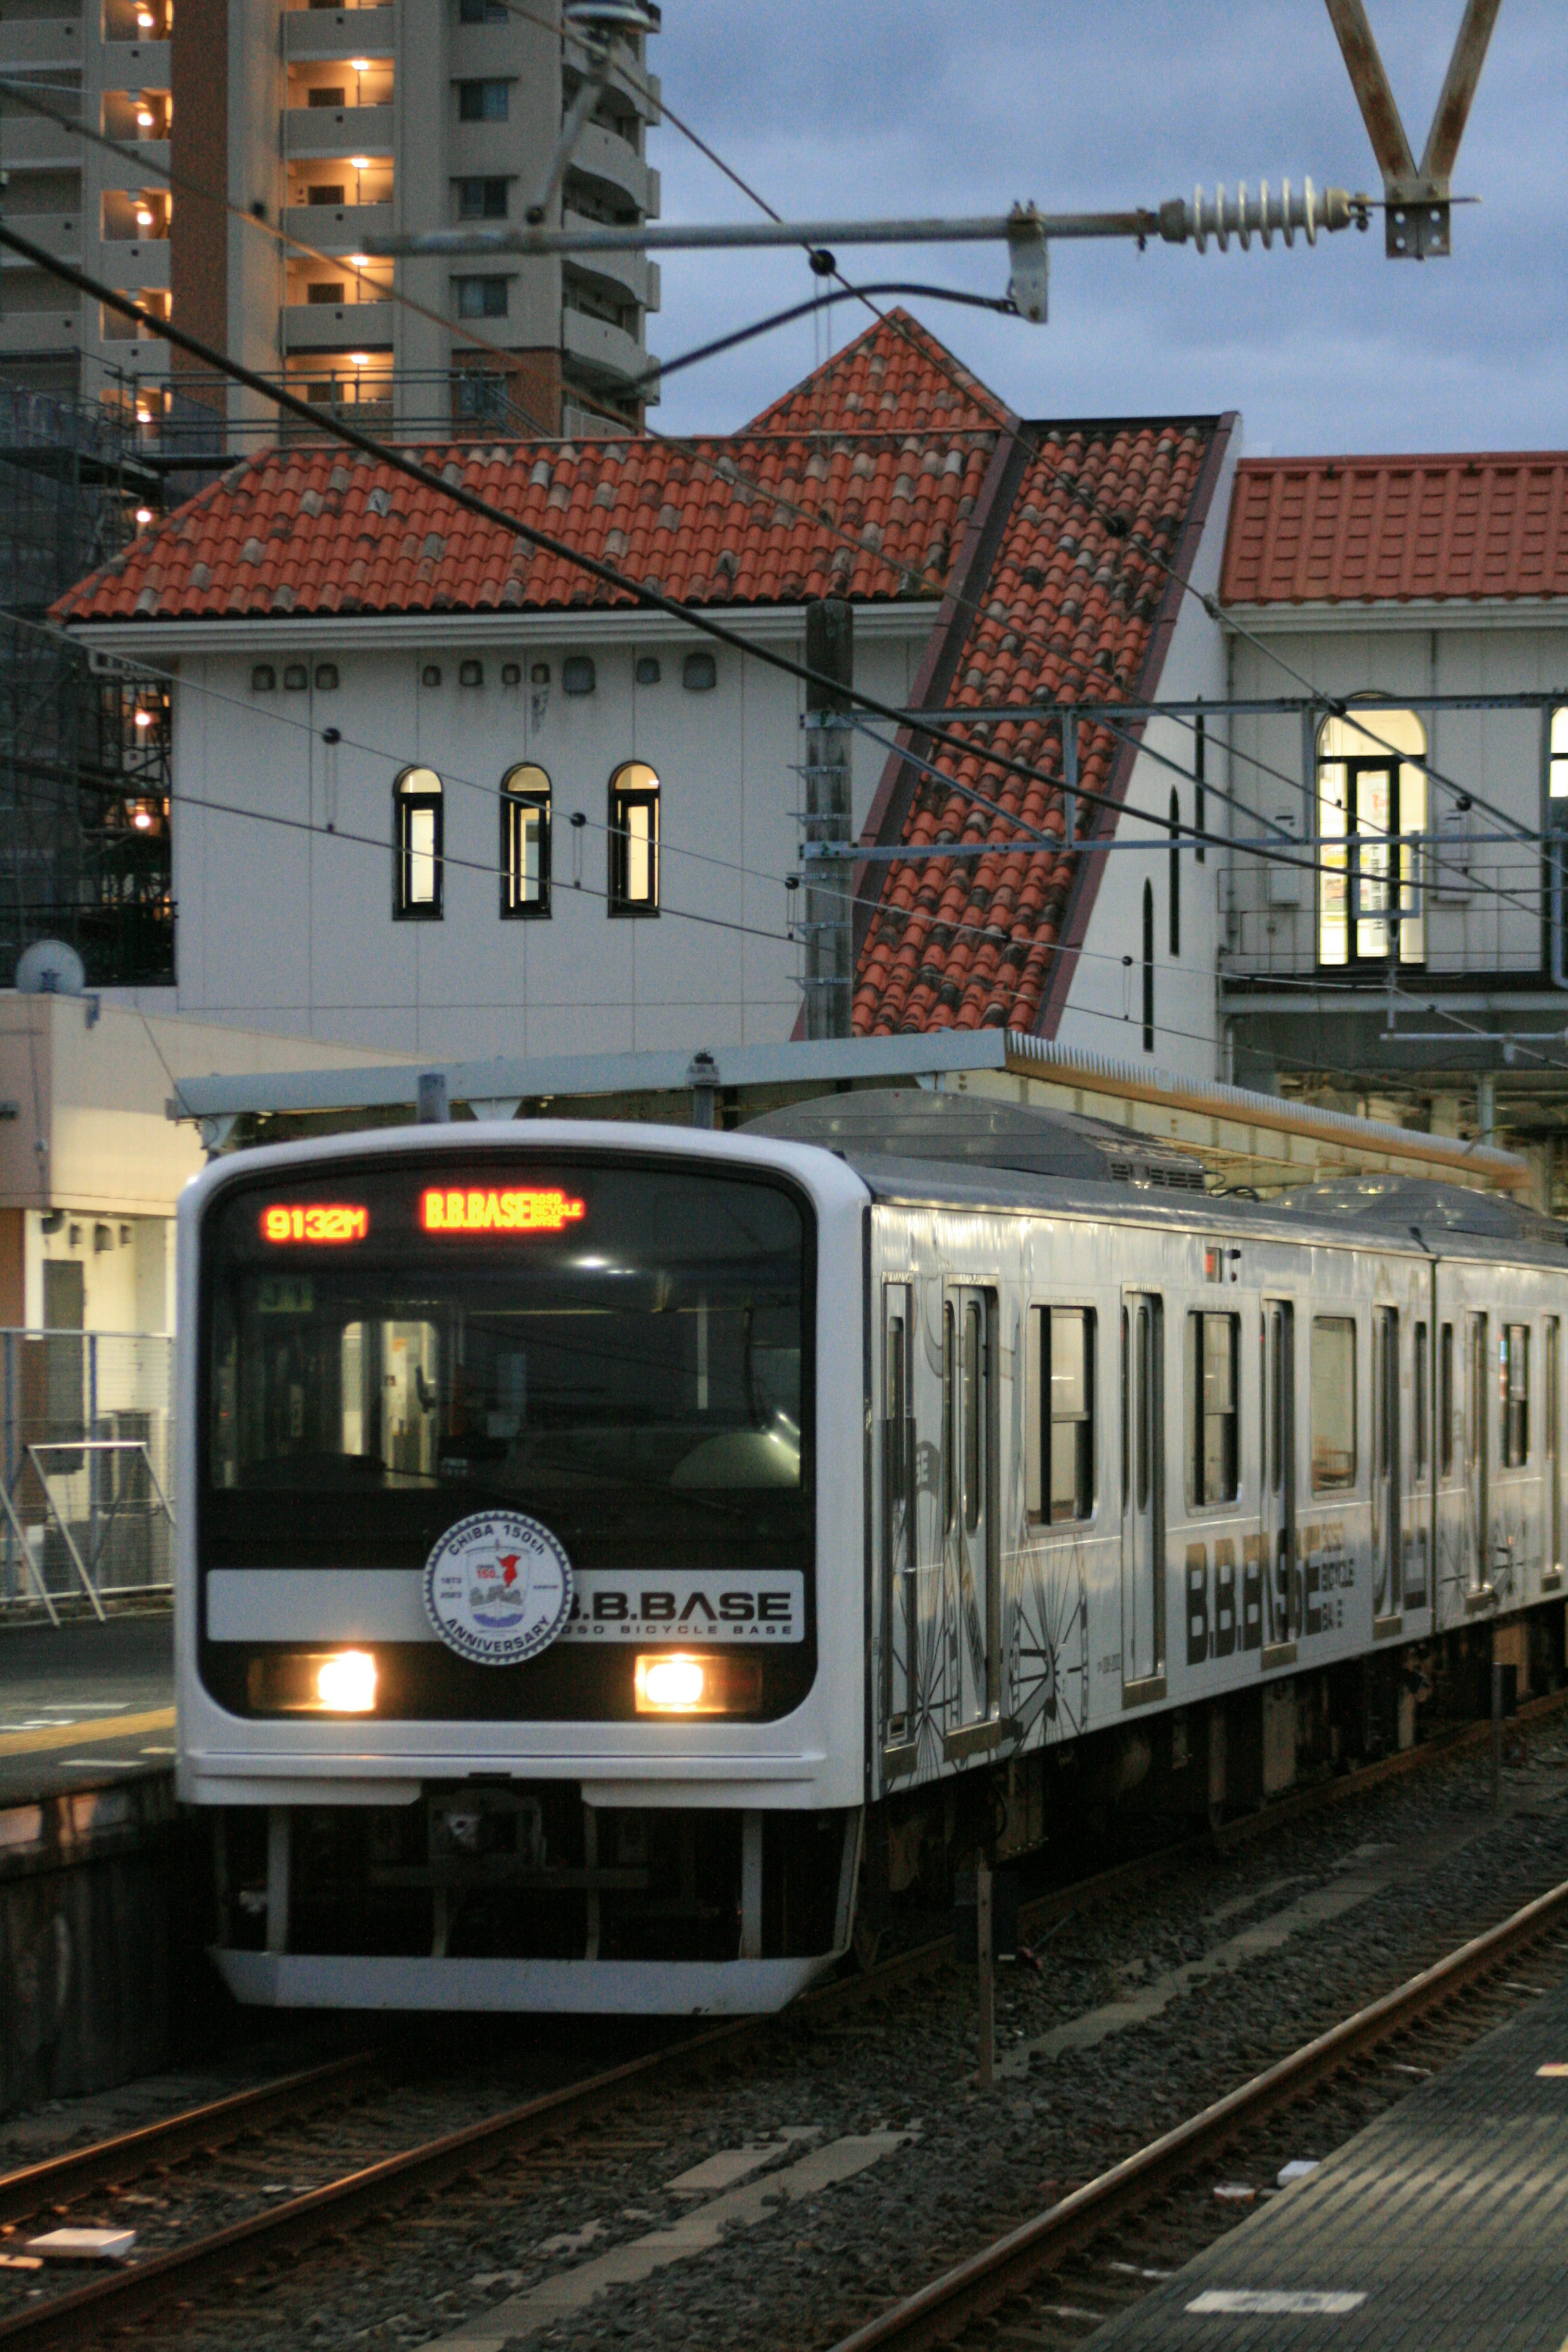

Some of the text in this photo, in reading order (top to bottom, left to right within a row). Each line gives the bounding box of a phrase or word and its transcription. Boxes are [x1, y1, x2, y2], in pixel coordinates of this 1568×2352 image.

[267, 1209, 366, 1239] 9132M
[425, 1192, 532, 1227] B.B.BASE
[449, 1524, 545, 1556] CHIBA 150th
[1185, 1525, 1321, 1666] B.B.BASE
[446, 1615, 550, 1652] ANNIVERSARY
[621, 1625, 718, 1634] BICYCLE
[733, 1625, 792, 1634] BASE
